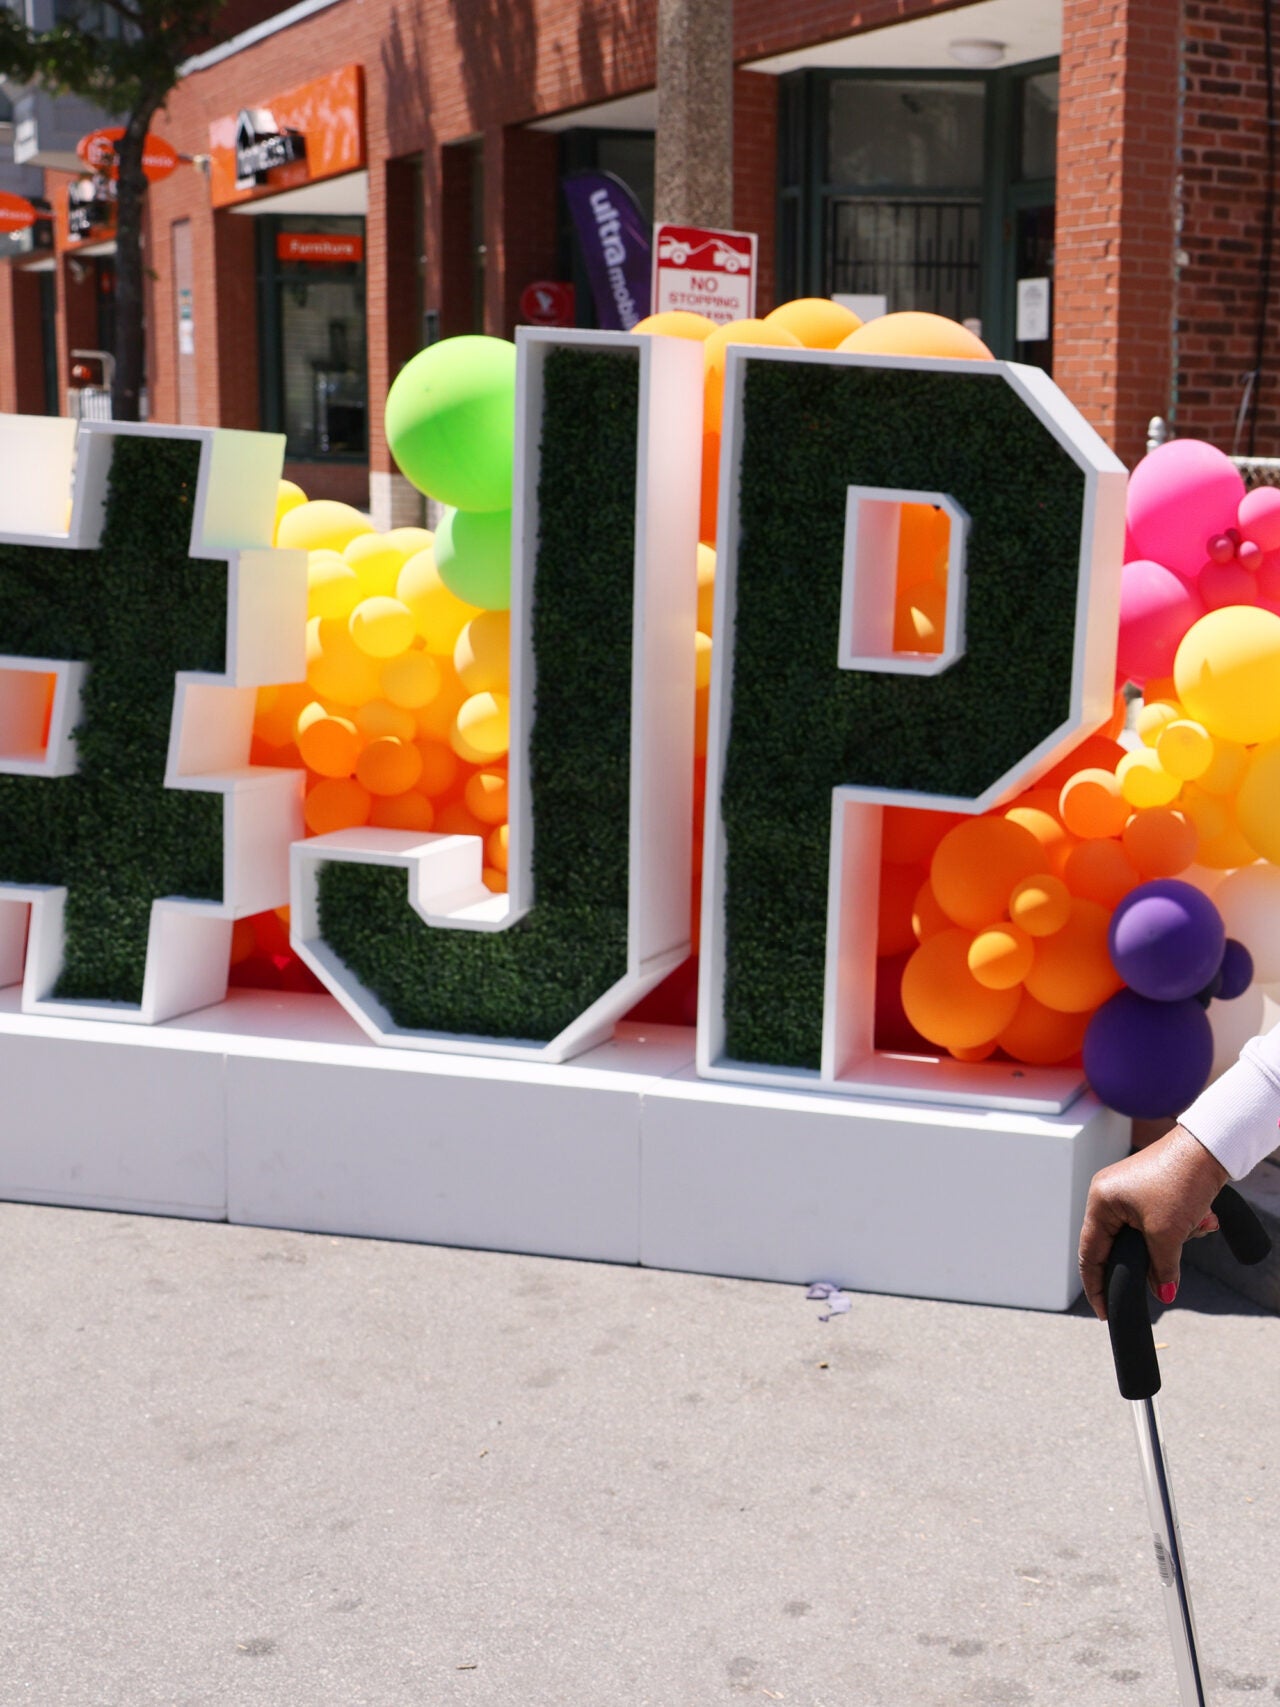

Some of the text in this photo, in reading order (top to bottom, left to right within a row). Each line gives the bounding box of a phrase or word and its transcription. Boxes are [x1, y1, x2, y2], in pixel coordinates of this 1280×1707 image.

[590, 188, 639, 330] ultra mobil
[690, 276, 719, 293] NO
[669, 292, 740, 308] STOPPING
